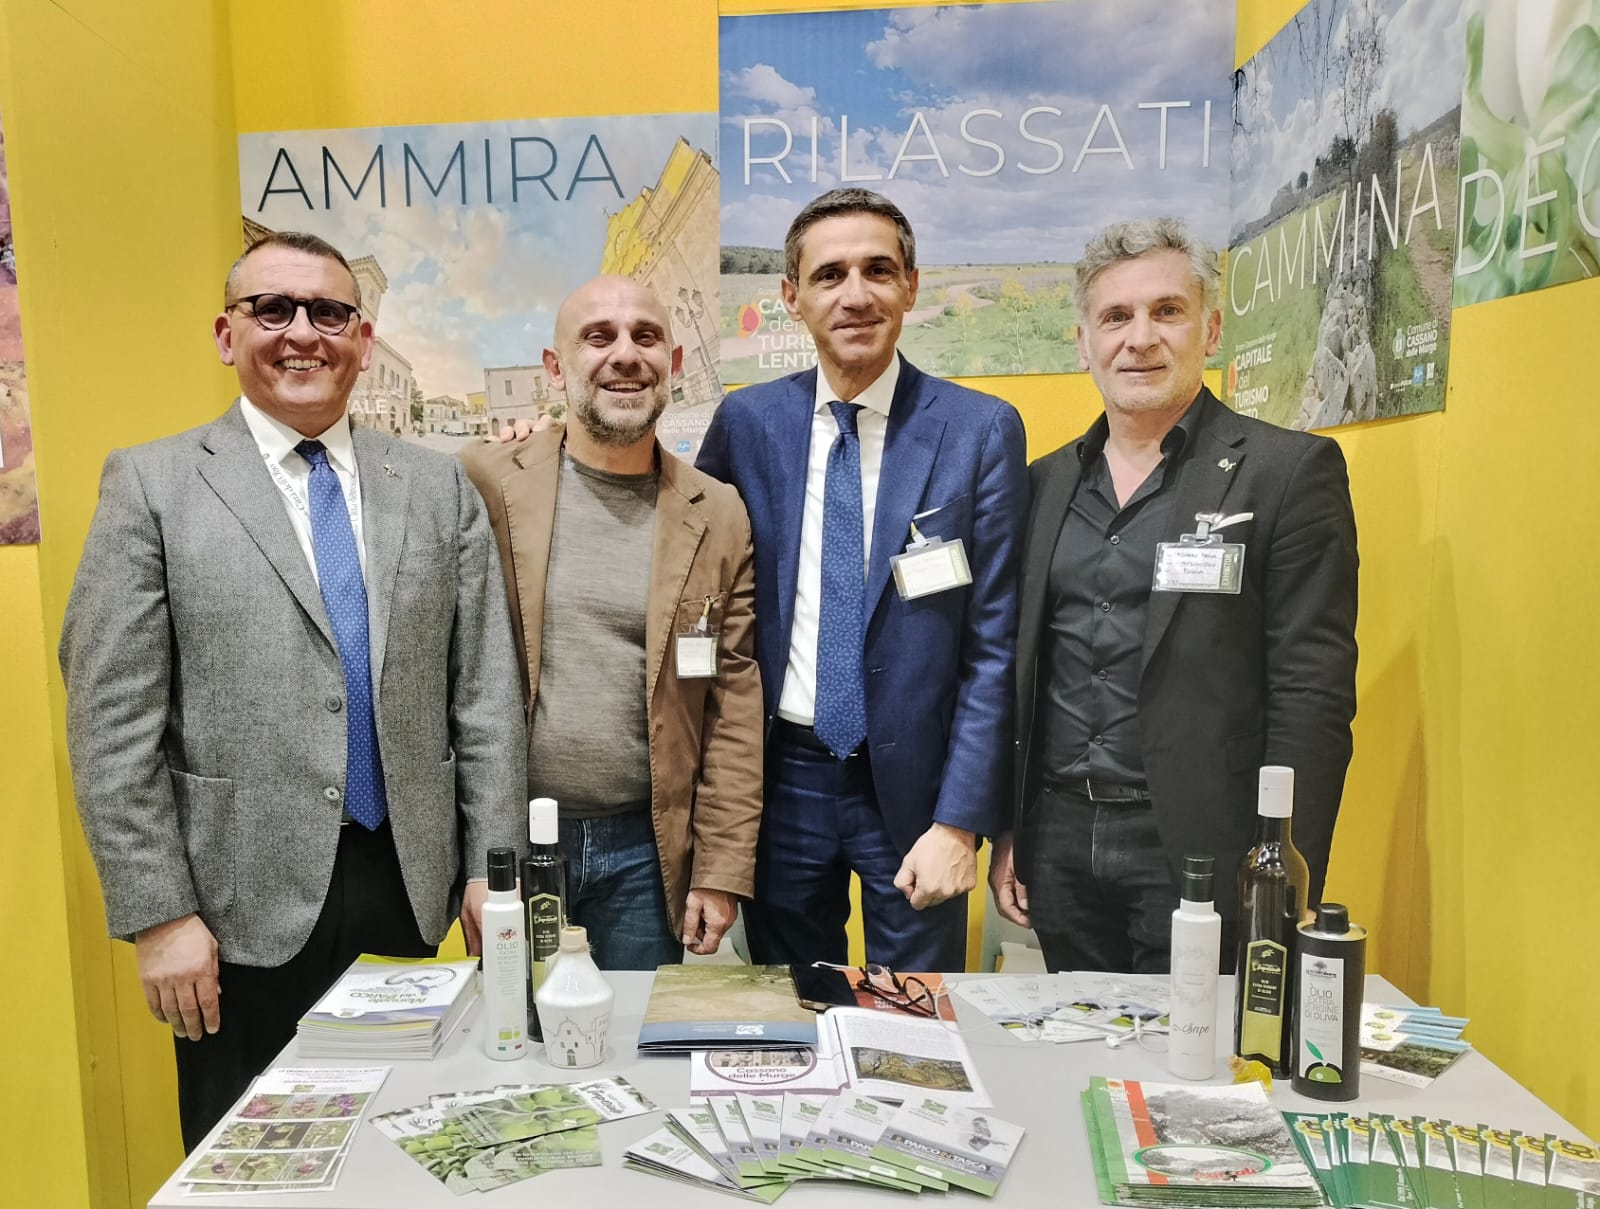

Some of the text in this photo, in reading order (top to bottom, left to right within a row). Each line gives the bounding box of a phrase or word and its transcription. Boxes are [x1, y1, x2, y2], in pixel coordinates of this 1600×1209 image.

[743, 100, 1212, 185] RILASSATI
[258, 133, 625, 212] AMMIRA
[1231, 142, 1442, 316] CAMMINA
[758, 333, 816, 350] TURIS
[1407, 329, 1437, 347] CASSANO
[1236, 343, 1273, 370] CAPITALE
[1234, 385, 1269, 408] TURISMO
[497, 942, 519, 950] OLIO
[1310, 986, 1333, 999] OLIO
[759, 1072, 796, 1080] Murge
[903, 1139, 940, 1156] PARCO
[953, 1154, 988, 1171] TASCA
